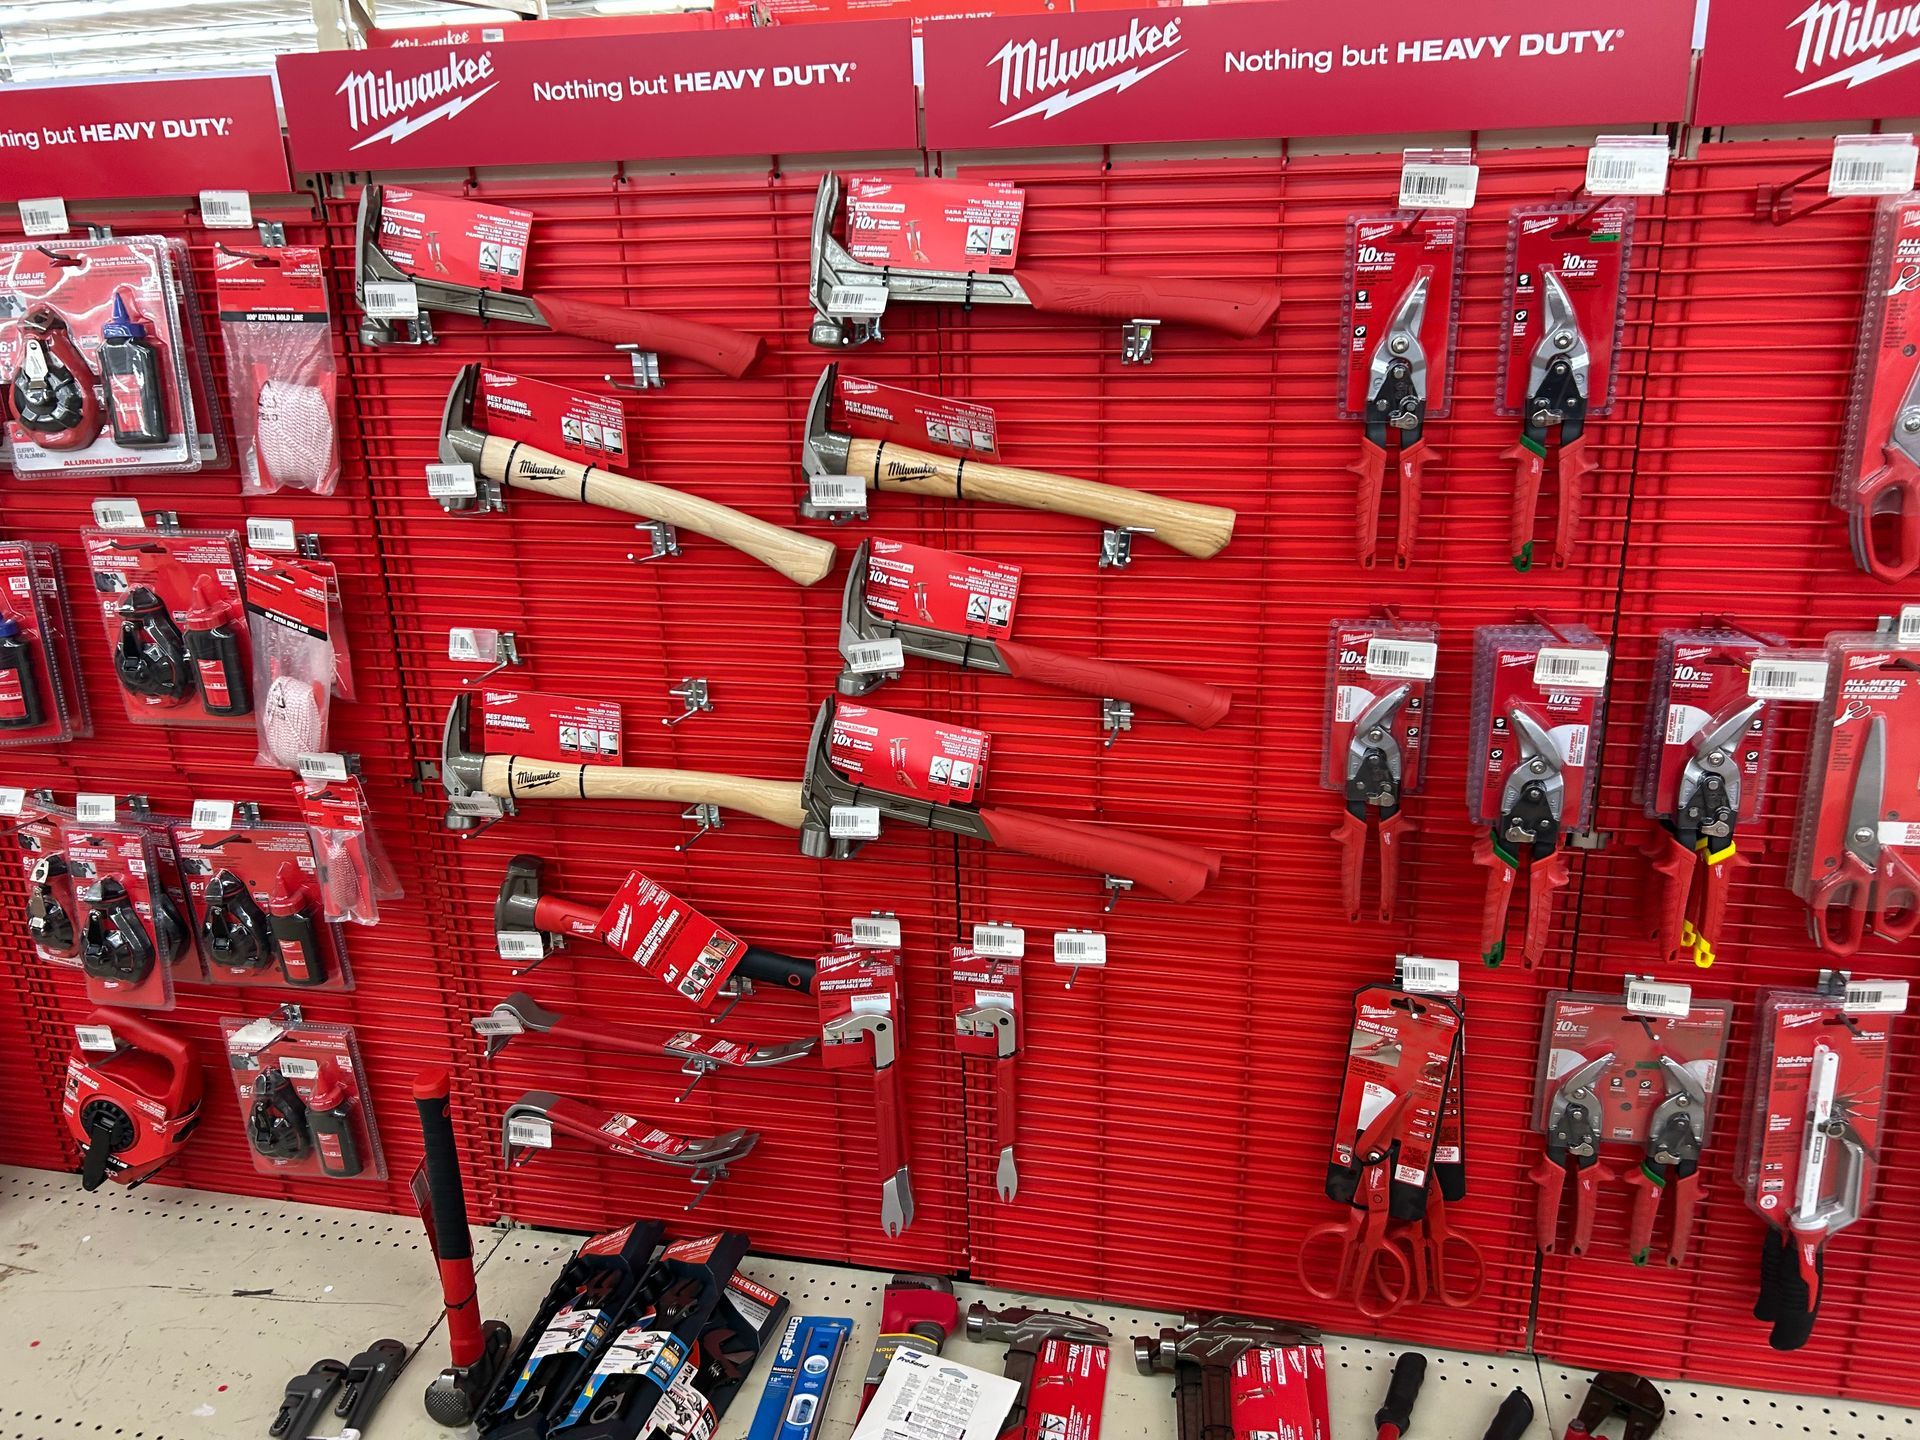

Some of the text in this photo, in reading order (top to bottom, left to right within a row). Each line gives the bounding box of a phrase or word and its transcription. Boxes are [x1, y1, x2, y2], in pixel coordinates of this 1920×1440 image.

[985, 17, 1182, 106] Milwaukee
[1225, 46, 1333, 74] Nothing
[1342, 44, 1389, 67] but
[1396, 35, 1512, 64] HEAVY
[335, 51, 495, 132] Milwaukee
[533, 79, 623, 102] Nothing
[628, 75, 669, 96] but
[673, 68, 766, 94] HEAVY
[44, 127, 77, 145] but
[80, 121, 156, 143] HEAVY
[1523, 217, 1558, 231] Milwaukee
[1360, 224, 1394, 239] Milwaukee
[1357, 247, 1383, 263] 10x
[1562, 255, 1587, 269] 10x
[484, 373, 517, 383] Milwaukee
[842, 380, 878, 390] Milwaukee
[487, 394, 528, 408] BEST DRIVING
[487, 402, 532, 416] PERFORMANCE
[845, 406, 894, 421] PERFORMANCE
[862, 403, 889, 414] DRIVING
[518, 459, 566, 476] Milwaukee
[887, 461, 938, 477] Milwaukee
[1340, 651, 1365, 663] 10x
[1502, 655, 1536, 663] Milwaukee
[1677, 648, 1712, 658] Milwaukee
[1849, 654, 1890, 667] Milwaukee
[1674, 666, 1701, 680] 10x
[1844, 679, 1907, 687] ALL-METAL
[485, 692, 518, 702] Milwaukee
[486, 720, 530, 729] PERFORMANCE
[501, 714, 527, 723] DRIVING
[516, 770, 560, 785] Milwaukee
[190, 881, 204, 890] 6:1
[607, 902, 629, 947] Milwaukee
[660, 909, 679, 938] HAMMER
[632, 945, 645, 963] MOST
[643, 915, 666, 949] VERSATILE
[818, 952, 861, 968] Milwaukee
[1361, 1004, 1397, 1015] Milwaukee
[1559, 1006, 1594, 1014] Milwaukee
[1667, 1019, 1675, 1027] 2
[1782, 1011, 1823, 1025] Milwaukee
[1358, 1019, 1399, 1035] TOUGH CUTS
[1556, 1021, 1577, 1032] 10x
[585, 1226, 630, 1249] CRESCENT
[667, 1235, 718, 1254] CRESCENT
[780, 1316, 802, 1358] Empire
[659, 1359, 671, 1371] MM
[684, 1365, 693, 1373] 3
[897, 1356, 930, 1369] ProSand
[669, 1389, 684, 1405] JAW
